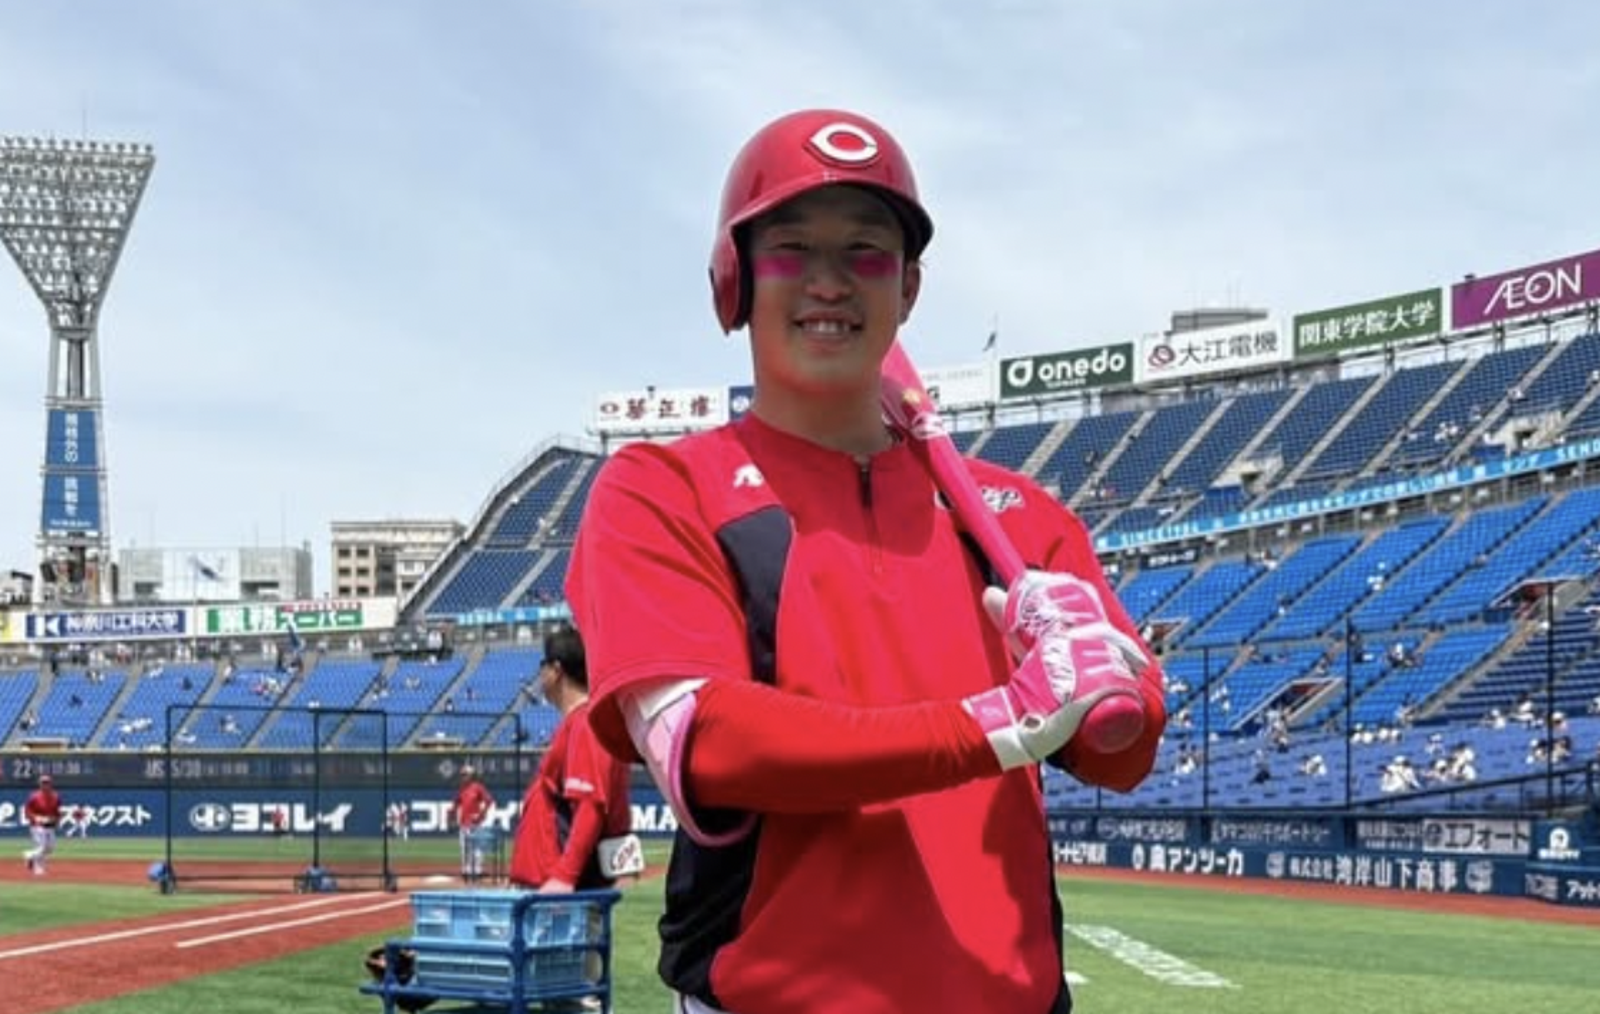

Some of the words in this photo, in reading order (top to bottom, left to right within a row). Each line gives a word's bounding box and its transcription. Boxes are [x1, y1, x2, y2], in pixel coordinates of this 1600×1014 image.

[808, 122, 878, 161] C
[1299, 300, 1435, 347] 関東学院大学
[1037, 349, 1127, 382] onedo
[1179, 330, 1278, 366] 大江電機
[1445, 822, 1528, 849] エフォート
